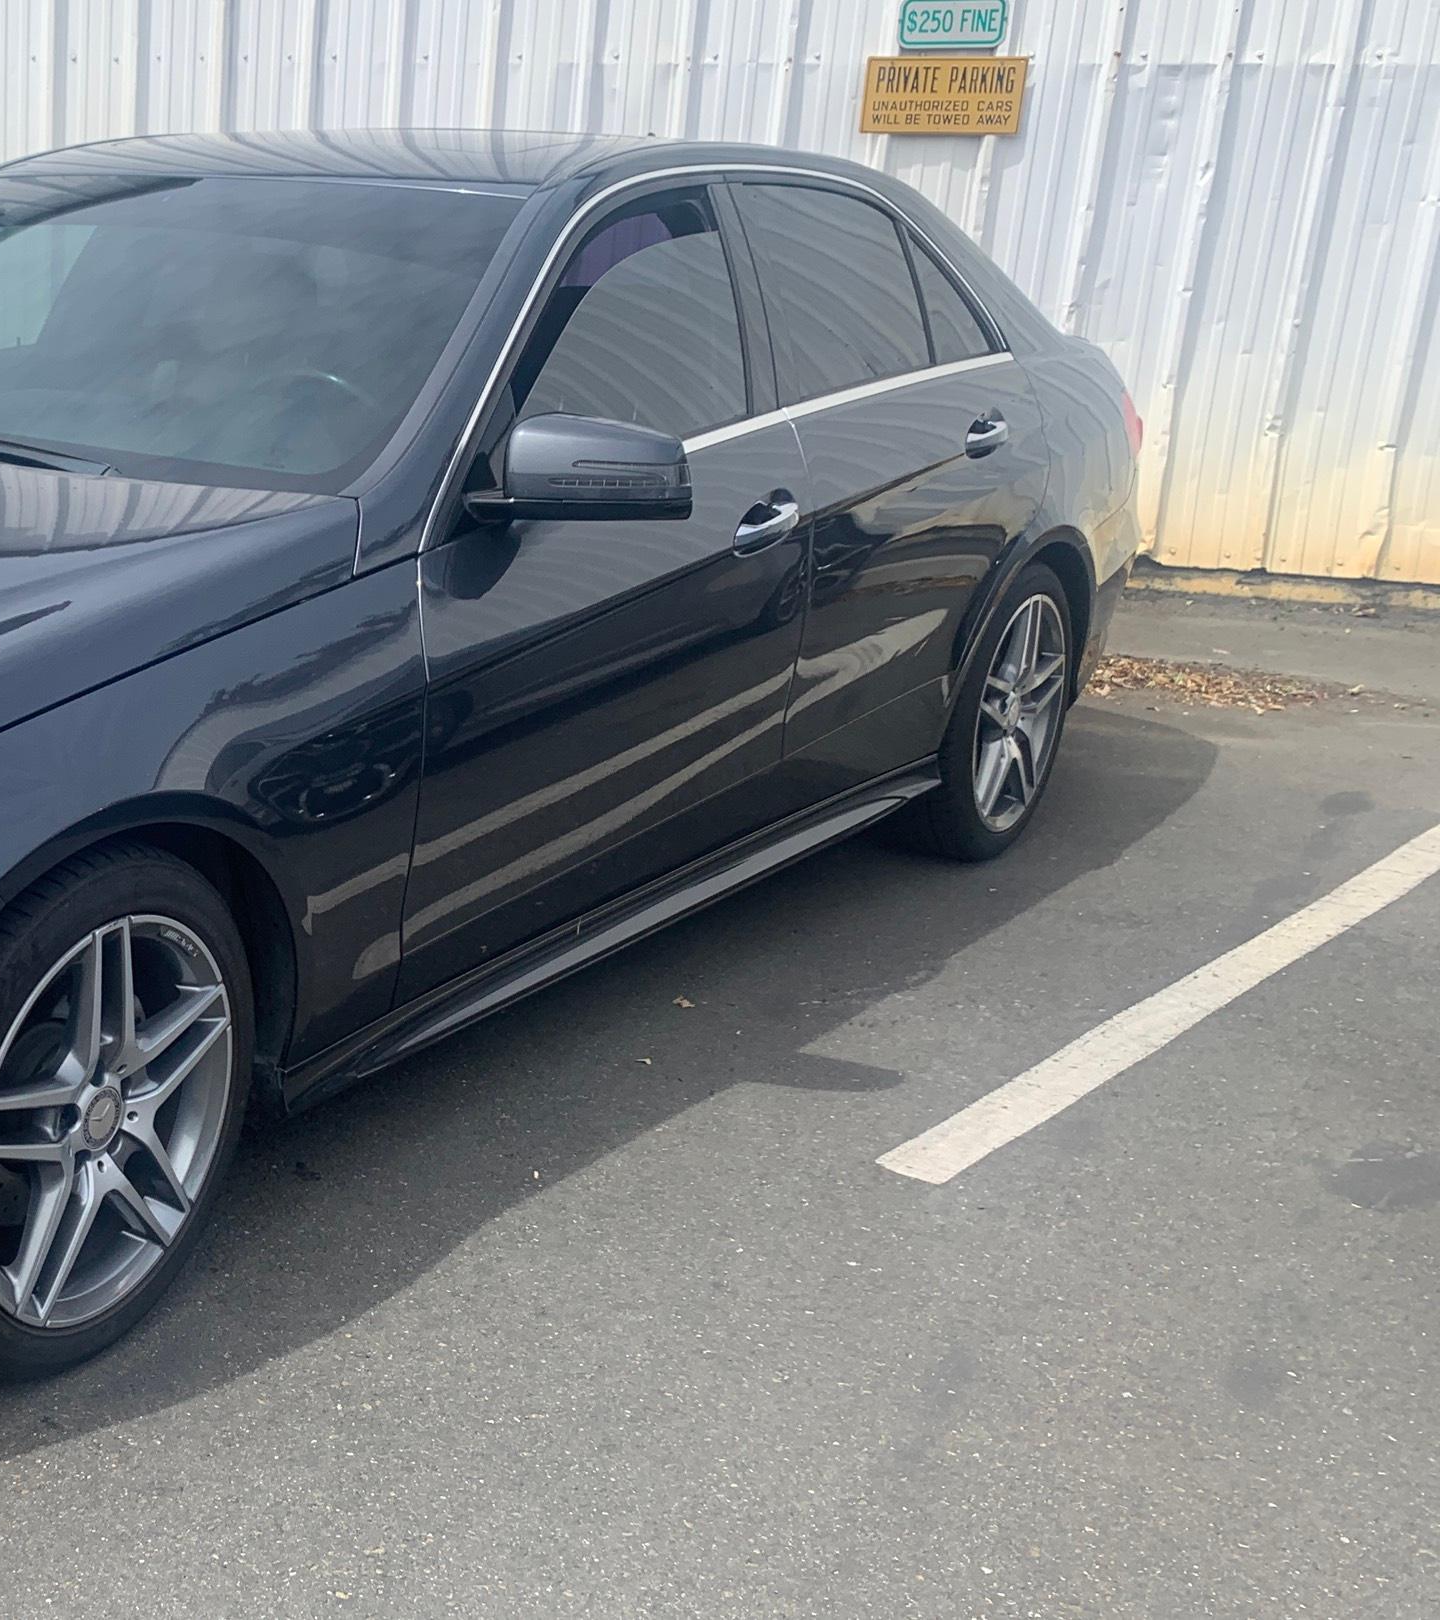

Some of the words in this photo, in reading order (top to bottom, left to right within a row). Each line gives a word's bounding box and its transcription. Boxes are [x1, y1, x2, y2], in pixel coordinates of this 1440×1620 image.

[906, 9, 954, 34] $250
[960, 8, 999, 33] FINE
[875, 66, 941, 94] PRIVATE
[948, 66, 1016, 94] PARKING
[872, 100, 969, 112] UNAUTHORIZED
[976, 100, 1013, 112] CARS
[871, 113, 900, 125] WILL
[904, 113, 921, 125] BE
[926, 113, 970, 126] TOWED
[976, 114, 1011, 126] AWAY
